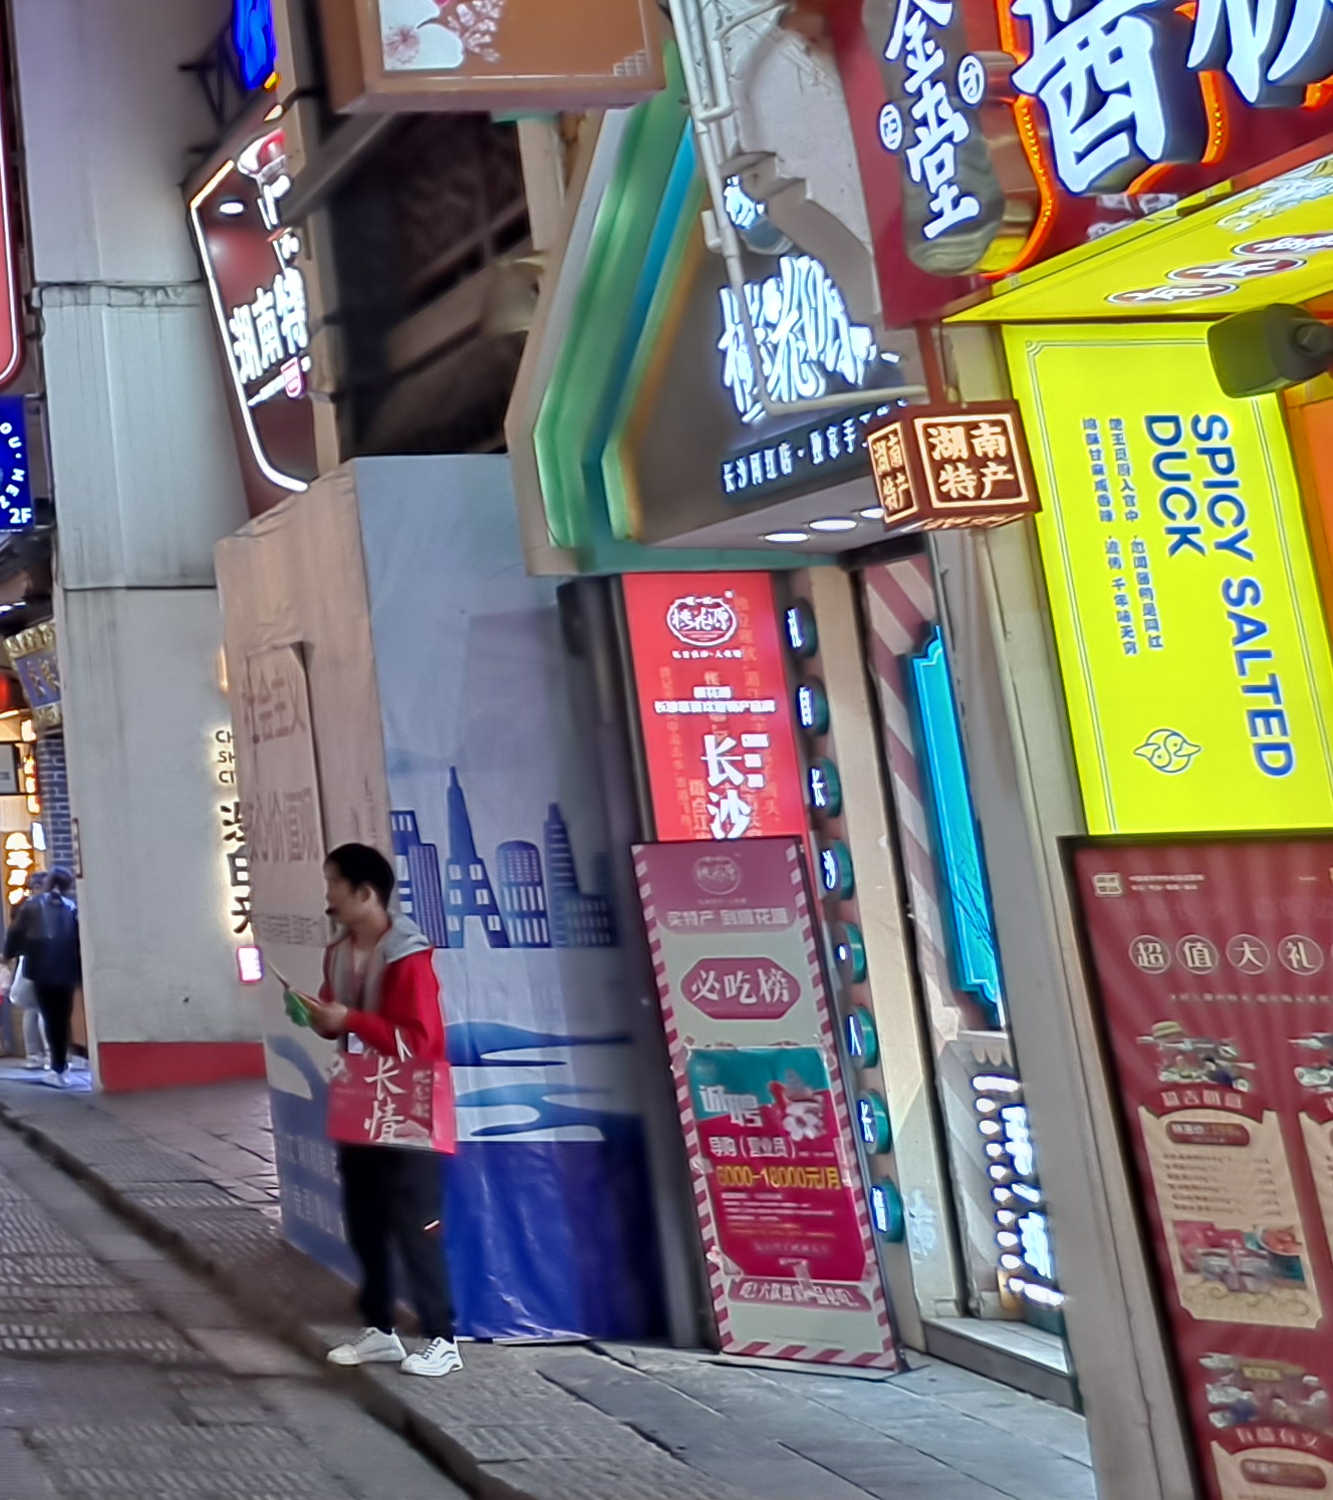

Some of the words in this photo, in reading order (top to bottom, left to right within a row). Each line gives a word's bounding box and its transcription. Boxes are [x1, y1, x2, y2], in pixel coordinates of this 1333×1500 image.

[927, 422, 1008, 461] 湖南
[938, 461, 1015, 498] 特产
[1144, 414, 1207, 557] DUCK
[1189, 413, 1256, 563] SPICY
[9, 508, 32, 524] 2F
[1222, 577, 1294, 777] SALTED
[1136, 940, 1316, 969] 超值大礼
[691, 968, 790, 1004] 必吃榜
